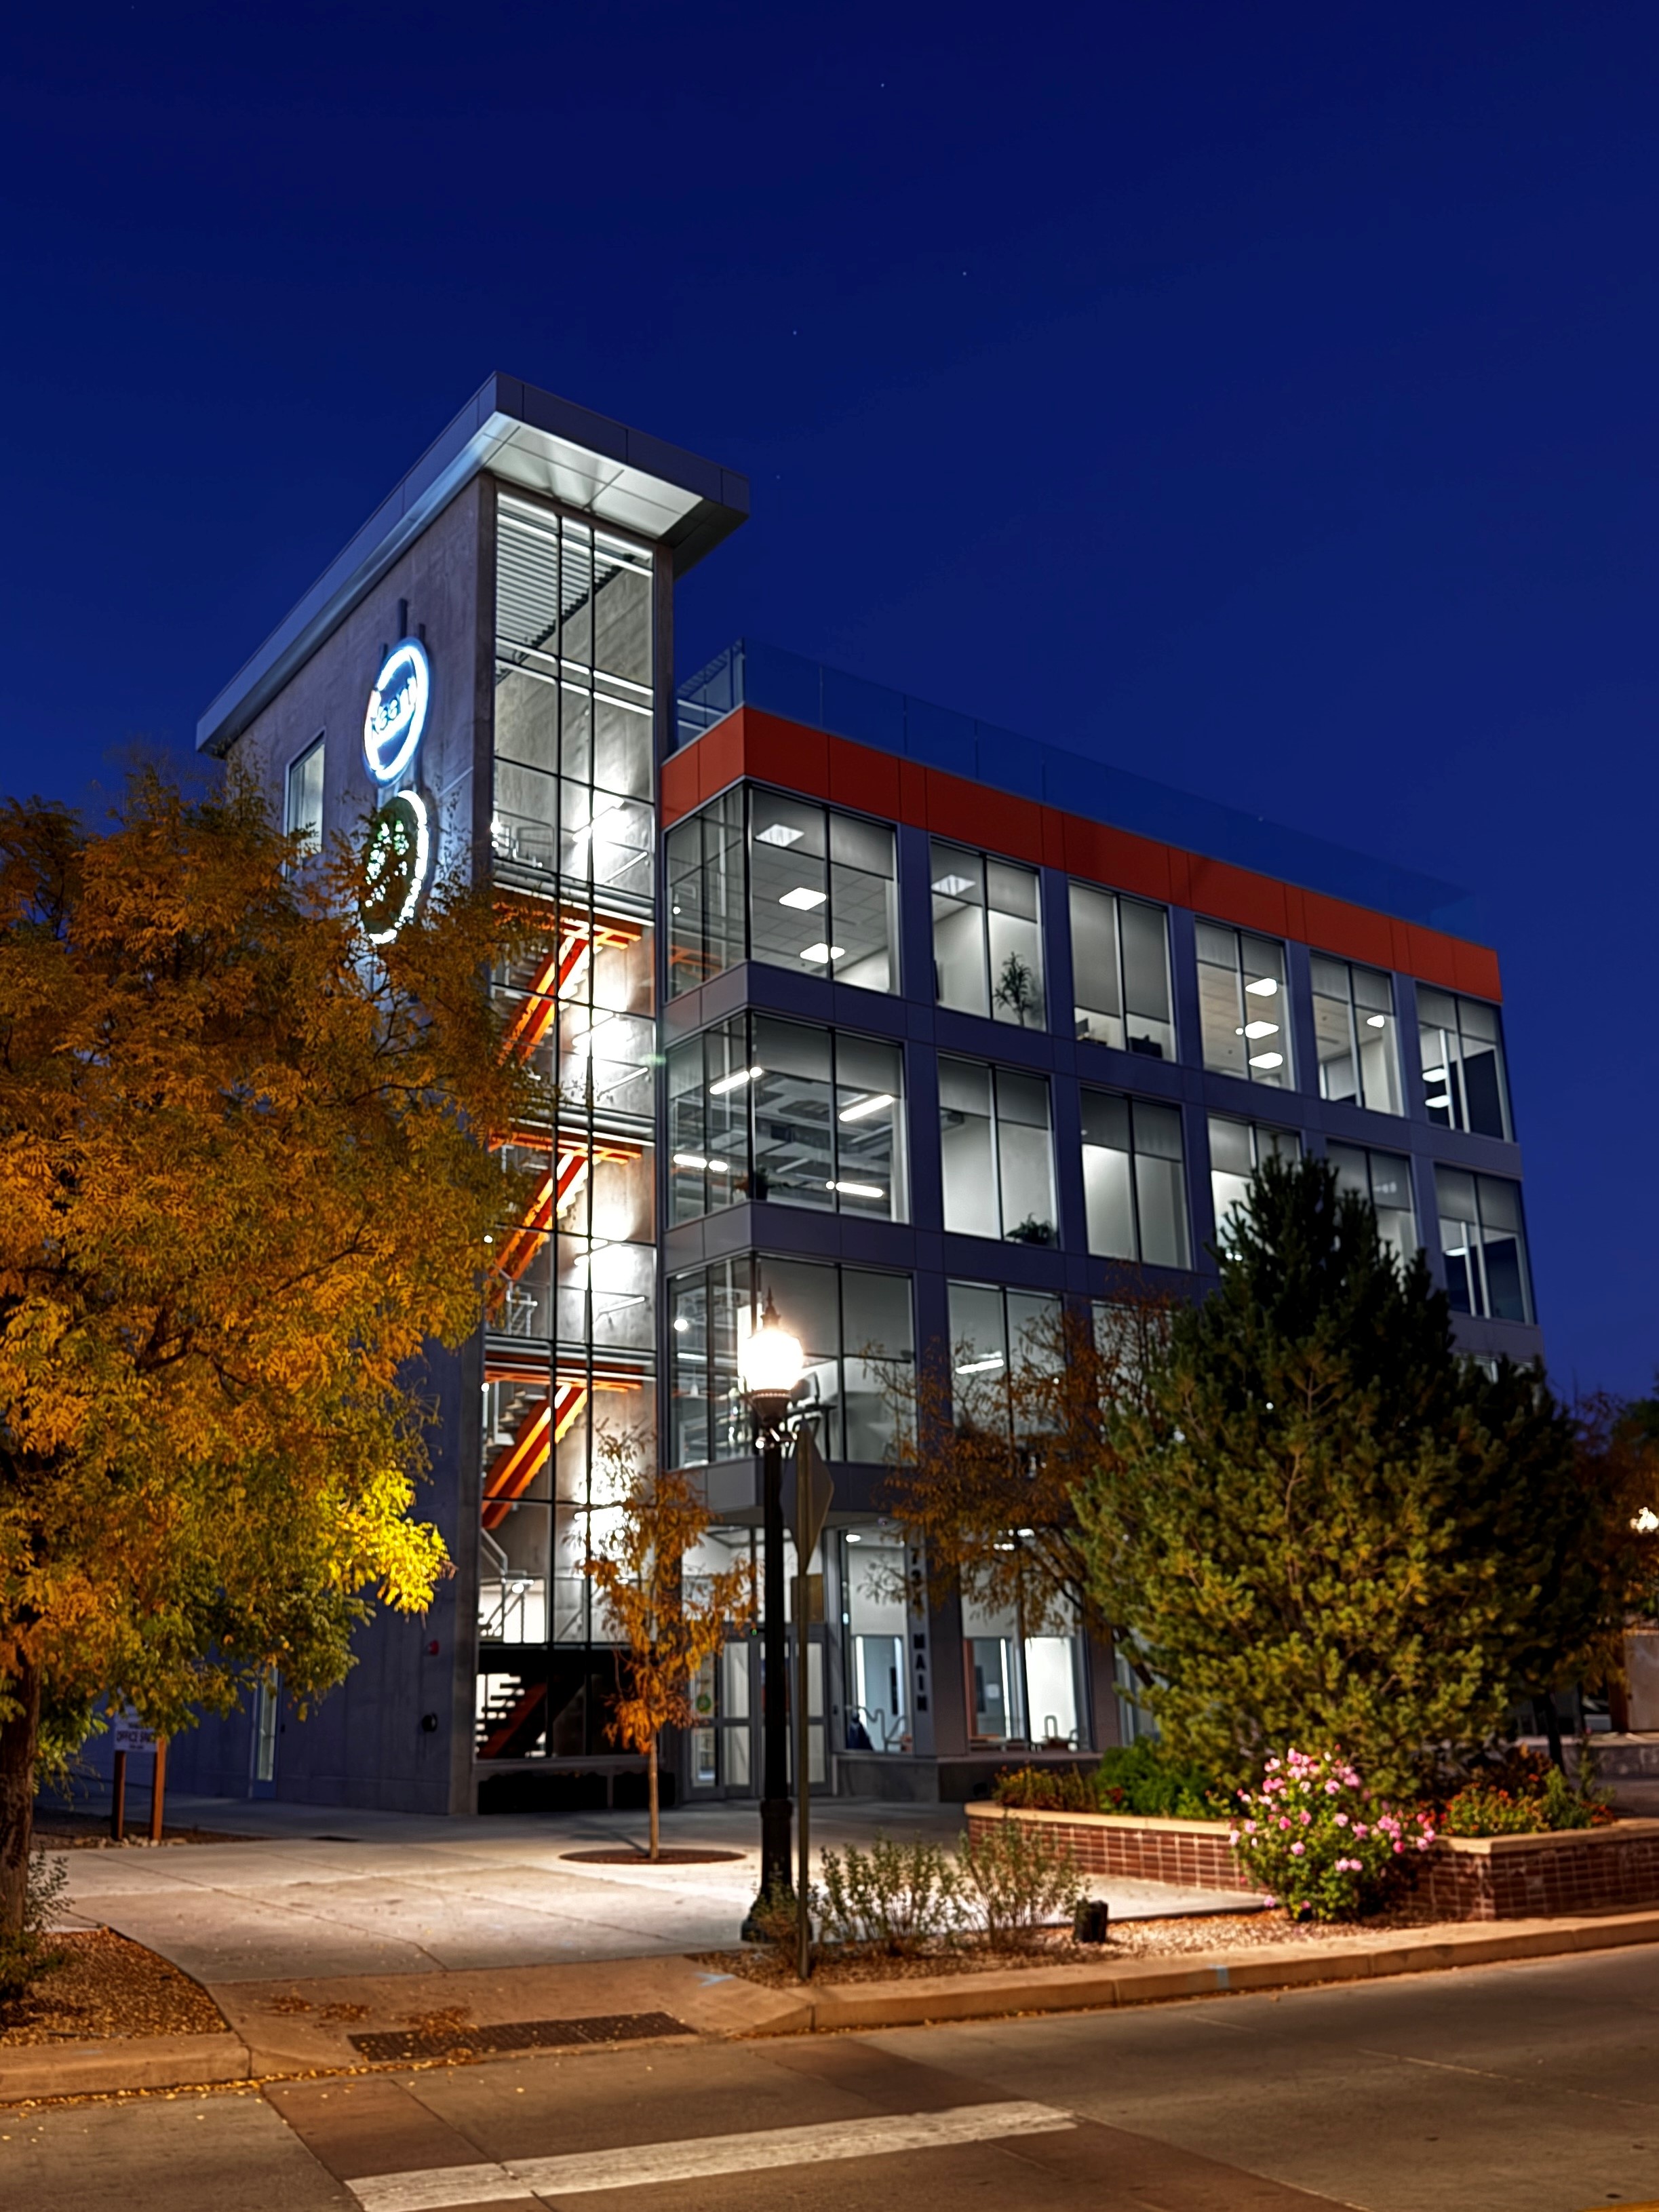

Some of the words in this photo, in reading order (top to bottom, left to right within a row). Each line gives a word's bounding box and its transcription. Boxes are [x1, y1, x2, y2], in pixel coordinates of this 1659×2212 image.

[913, 1633, 927, 1711] MAIN
[116, 1730, 138, 1743] OFFICE
[140, 1730, 156, 1743] SPA
